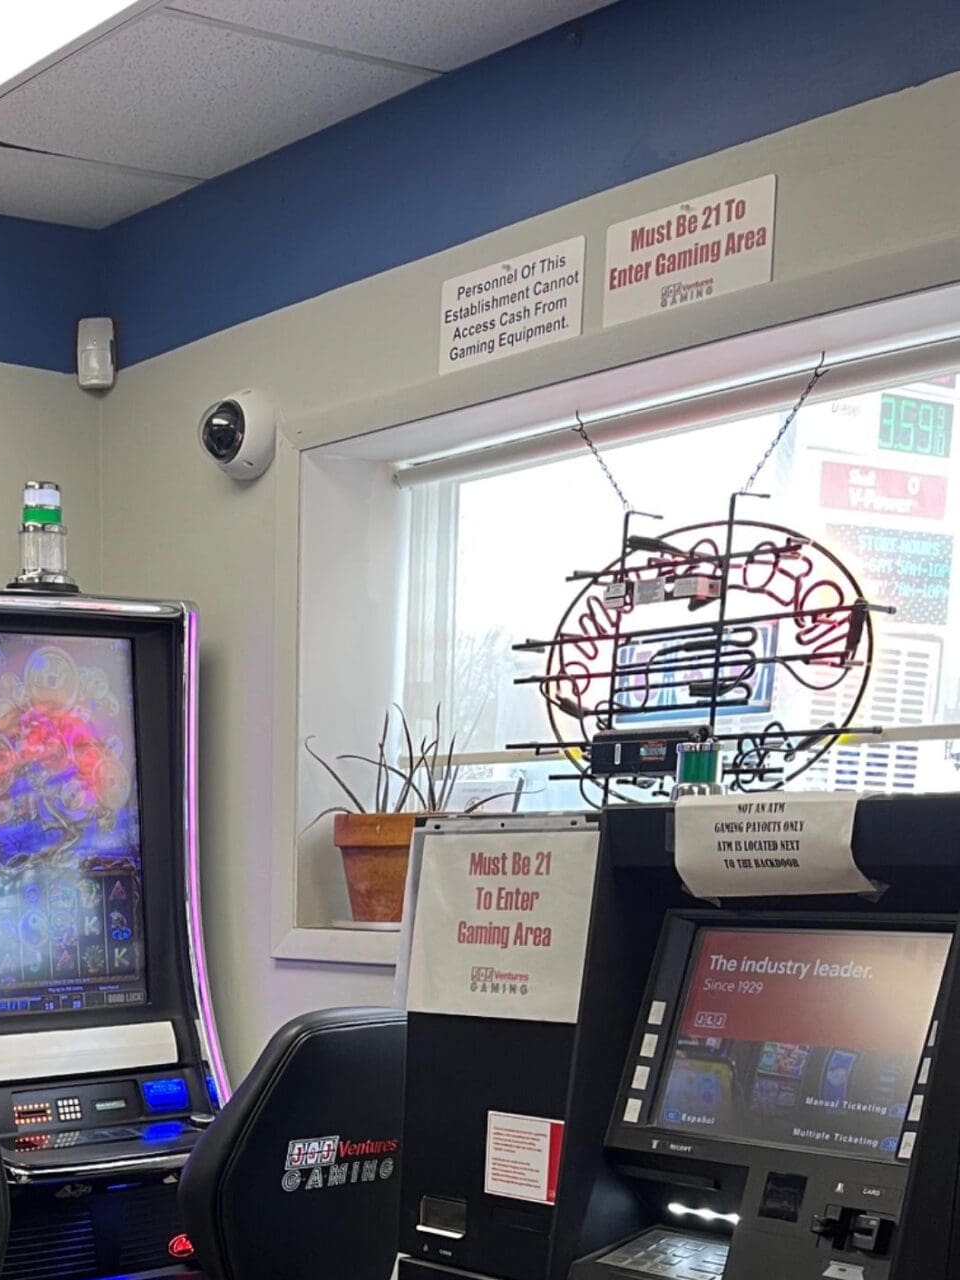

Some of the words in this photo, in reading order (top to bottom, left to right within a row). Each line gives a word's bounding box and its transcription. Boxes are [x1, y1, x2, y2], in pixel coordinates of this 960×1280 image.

[631, 222, 673, 252] Must
[676, 213, 699, 237] Be
[701, 206, 721, 230] 21
[723, 198, 747, 222] To
[609, 262, 652, 292] Enter
[655, 239, 721, 278] Gaming
[724, 226, 767, 257] Area
[457, 269, 518, 300] Personnel
[521, 262, 537, 279] Of
[539, 254, 567, 275] This
[444, 288, 530, 324] Establishment
[533, 270, 580, 296] Cannot
[661, 286, 713, 307] GAMING
[452, 319, 496, 342] Access
[499, 308, 532, 328] Cash
[534, 296, 568, 318] From
[449, 337, 495, 362] Gaming
[498, 316, 569, 350] Equipment.
[737, 802, 753, 814] NOT
[755, 802, 766, 813] AN
[768, 802, 785, 813] ATM
[714, 822, 744, 833] GAMING
[745, 820, 781, 833] PAYOUTS
[783, 820, 805, 832] ONLY
[717, 840, 733, 851] ATM
[734, 840, 743, 851] IS
[744, 840, 778, 851] LOCATED
[780, 839, 800, 851] NEXT
[469, 851, 508, 876] Must
[511, 851, 531, 876] Be
[534, 851, 552, 876] 21
[724, 858, 735, 869] TO
[737, 858, 752, 869] THE
[753, 858, 800, 869] BACKDOOR
[476, 887, 493, 911] To
[496, 887, 540, 911] Enter
[457, 921, 510, 949] Gaming
[513, 922, 552, 947] Area
[709, 955, 737, 972] The
[740, 956, 810, 980] industry
[814, 960, 874, 979] leader.
[470, 982, 529, 996] GAMING
[703, 978, 735, 993] Since
[738, 980, 763, 994] 1929
[805, 1096, 840, 1110] Manual
[842, 1100, 888, 1115] Ticketing
[681, 1112, 716, 1125] Español
[792, 1127, 831, 1142] Multiple
[834, 1132, 879, 1148] Ticketing
[339, 1139, 398, 1158] Ventures
[281, 1157, 394, 1192] GAMING
[862, 1187, 881, 1197] CARD
